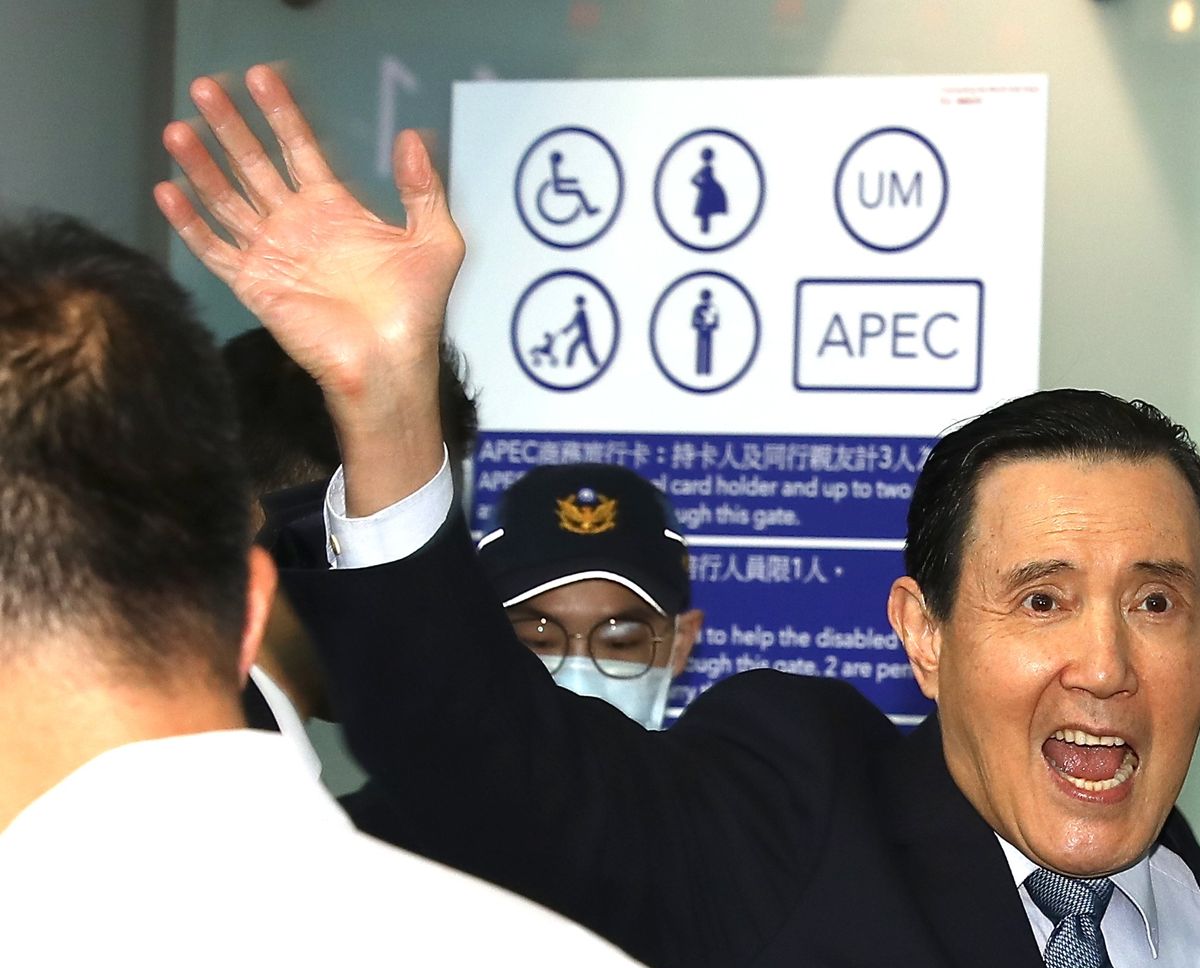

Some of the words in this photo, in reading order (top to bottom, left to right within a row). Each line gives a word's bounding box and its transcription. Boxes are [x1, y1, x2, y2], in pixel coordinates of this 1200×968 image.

[858, 171, 923, 209] UM
[817, 312, 959, 360] APEC
[670, 474, 712, 497] card
[715, 474, 777, 498] holder
[780, 476, 819, 498] and
[822, 481, 848, 503] up
[851, 480, 873, 500] to
[875, 480, 913, 500] two
[715, 502, 750, 526] this
[706, 628, 728, 646] to
[731, 624, 776, 651] help
[778, 625, 811, 648] the
[815, 627, 899, 649] disabled
[824, 655, 838, 677] 2
[841, 662, 872, 679] are
